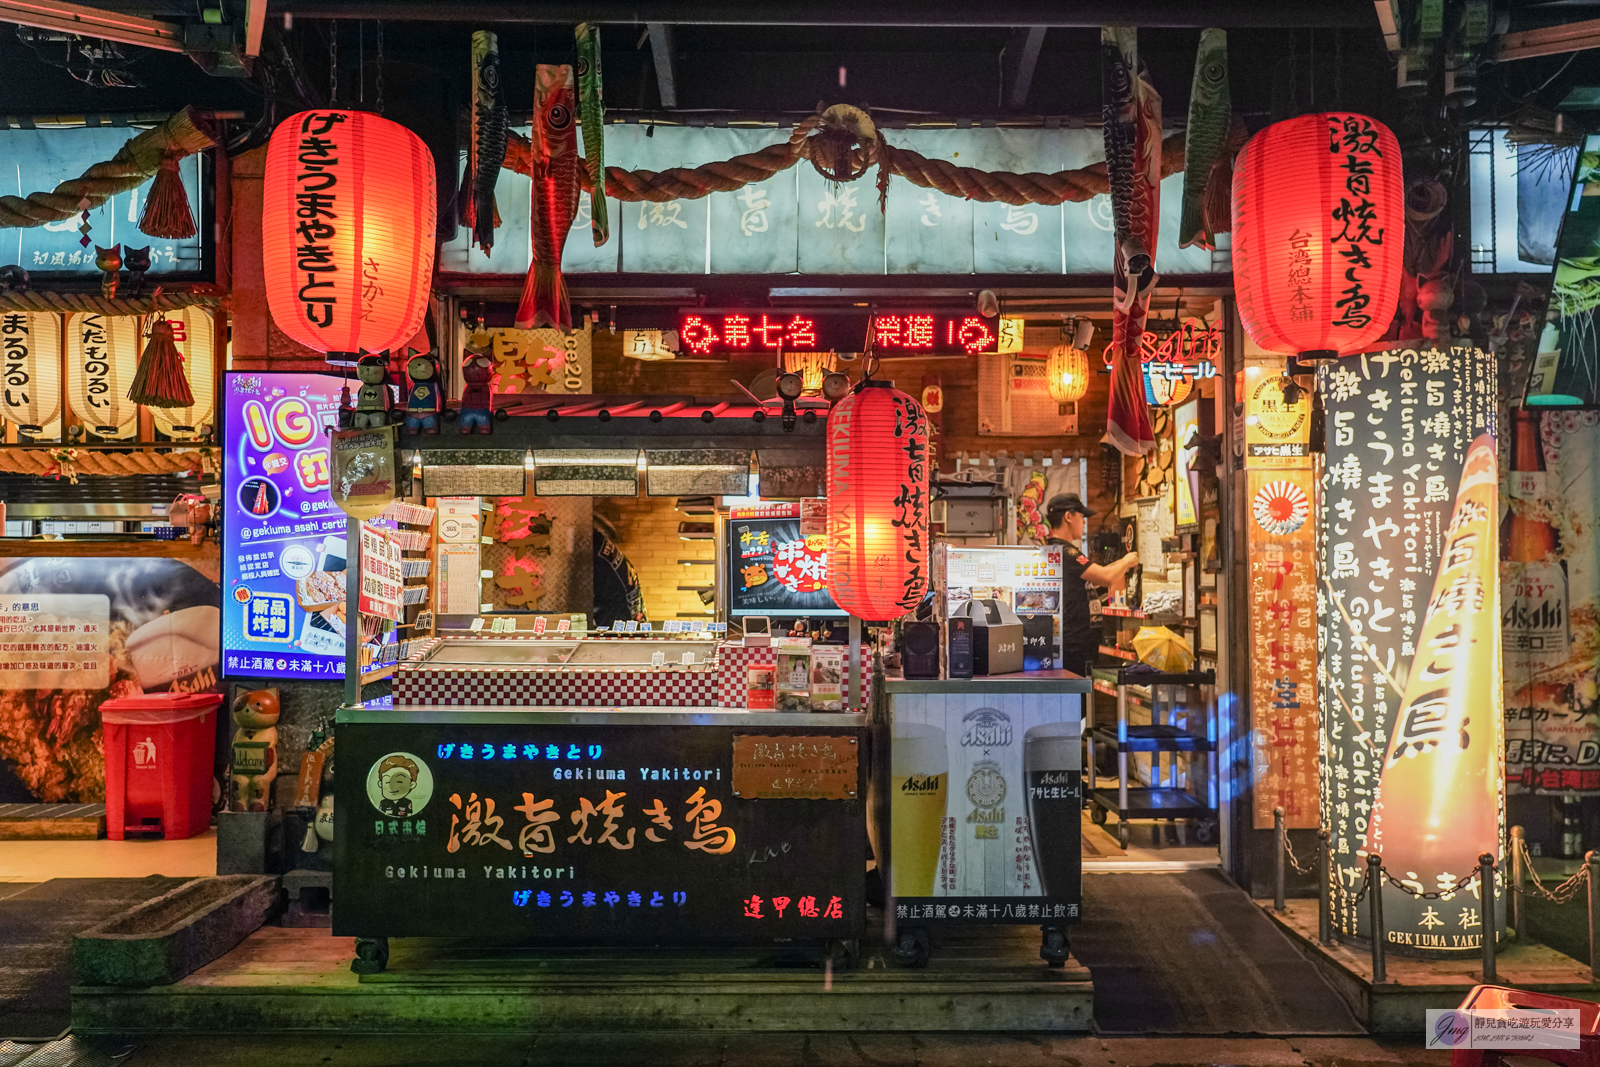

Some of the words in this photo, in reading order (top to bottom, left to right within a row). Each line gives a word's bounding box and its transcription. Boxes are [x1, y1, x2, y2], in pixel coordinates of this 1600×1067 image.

[296, 113, 349, 328] げきうまやきとり
[358, 257, 384, 324] さかえ
[725, 315, 815, 347] 第七名
[877, 315, 934, 347] 榮獲
[1400, 349, 1419, 457] Gekiuma
[243, 400, 318, 452] IG
[1361, 348, 1401, 674] げきうまやきとり
[1402, 463, 1423, 574] Yakitori
[740, 531, 769, 546] 牛舌
[252, 598, 286, 616] 新品
[252, 615, 286, 633] 炸物
[228, 655, 274, 671] 禁止酒駕
[1350, 597, 1370, 722] Gekiuma
[961, 723, 1013, 748] Asahi
[437, 743, 603, 760] げきうまやきとり
[553, 767, 626, 780] Gekiuma
[640, 767, 722, 781] Yakitori
[1040, 771, 1068, 785] Asahi
[901, 776, 939, 792] Asahi
[965, 807, 1006, 824] Asahi
[385, 866, 467, 879] Gekiuma
[483, 866, 575, 879] Yakitori
[512, 889, 688, 908] げきうまやきとり
[896, 904, 947, 919] 禁止酒駕
[962, 903, 1079, 919] 未滿十八歲禁止飲酒
[1388, 930, 1447, 947] GEKIUMA
